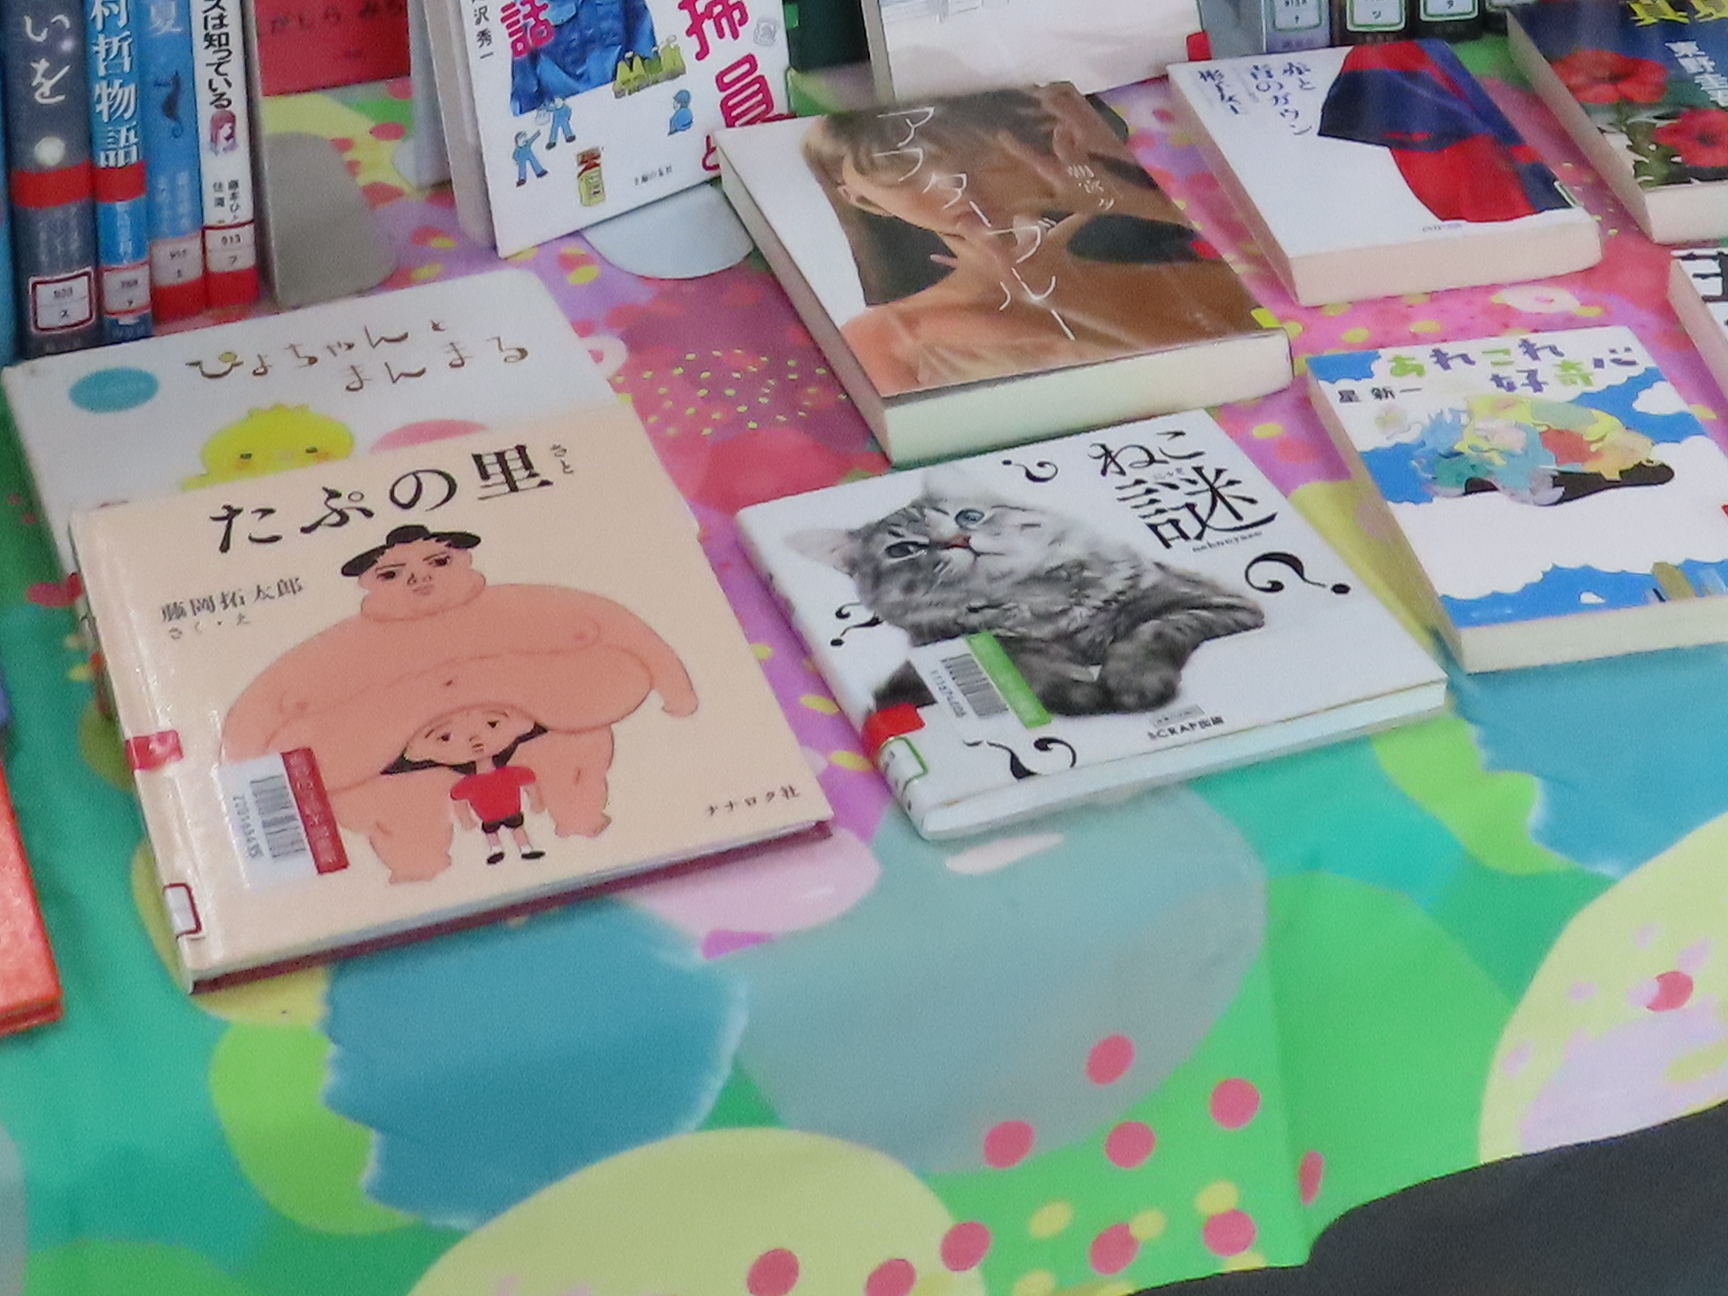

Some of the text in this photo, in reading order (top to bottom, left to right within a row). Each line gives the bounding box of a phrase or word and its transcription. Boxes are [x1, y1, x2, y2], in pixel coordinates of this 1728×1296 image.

[872, 106, 1077, 341] アフターブルー
[1387, 337, 1568, 382] あれこれ
[1489, 346, 1640, 396] 好奇心
[1090, 428, 1207, 480] ねこ
[210, 443, 554, 552] たぷの里
[1116, 464, 1279, 550] 謎
[160, 575, 304, 623] 藤岡拓太郎
